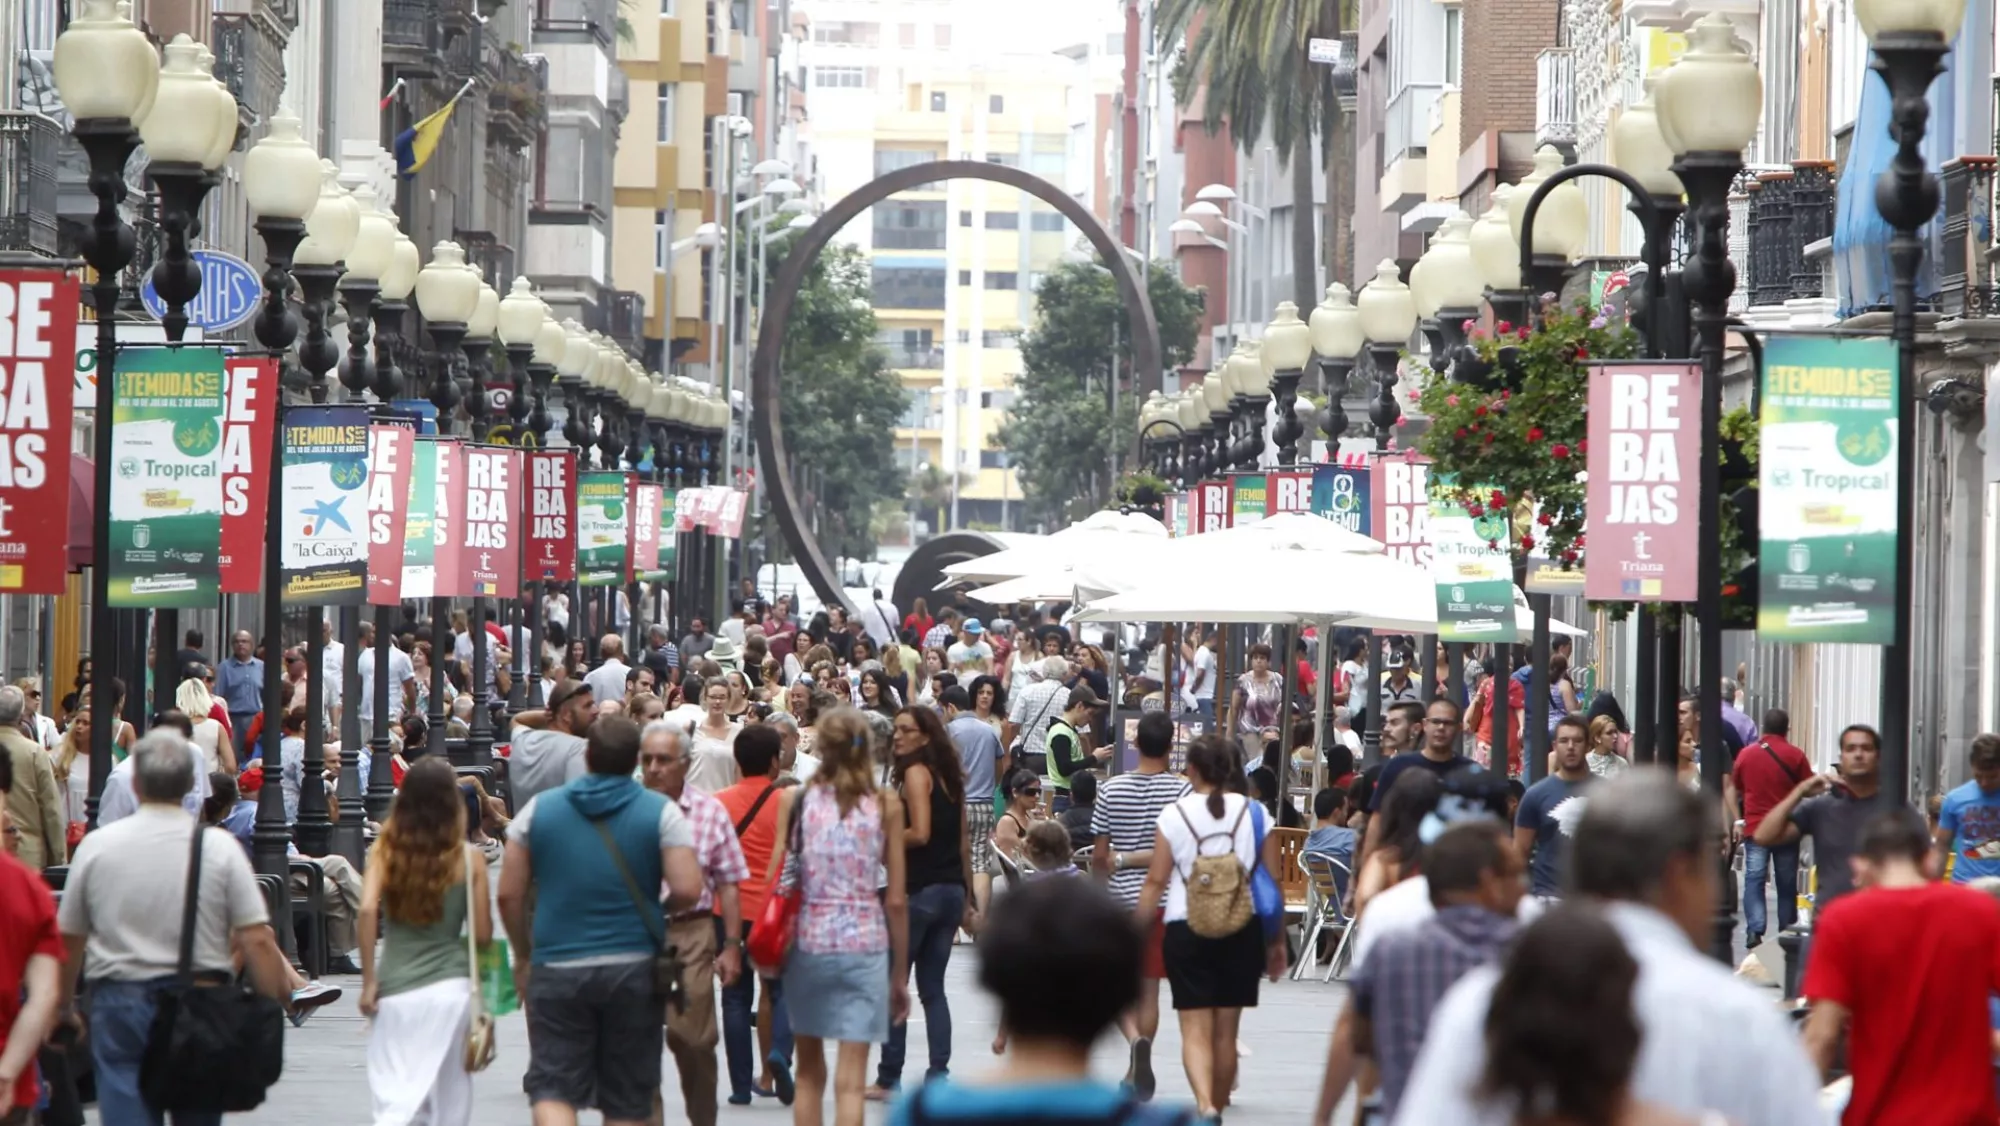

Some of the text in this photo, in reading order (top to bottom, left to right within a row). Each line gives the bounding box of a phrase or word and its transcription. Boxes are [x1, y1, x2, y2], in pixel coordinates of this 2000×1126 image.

[125, 372, 205, 397] TEMUDAS
[1777, 365, 1875, 397] TEMUDAS
[0, 362, 49, 429] A
[1610, 374, 1680, 430] RE
[292, 426, 355, 446] TEMUDAS
[1609, 432, 1681, 482] BA
[145, 460, 216, 481] Tropical
[468, 453, 508, 490] RE
[532, 456, 567, 488] RE
[1801, 469, 1889, 494] Tropical
[467, 489, 508, 523] BA
[533, 489, 567, 516] BA
[1239, 488, 1266, 501] TEMUD
[1277, 477, 1313, 510] RE
[1606, 484, 1678, 525] JAS
[465, 523, 507, 549] JAS
[532, 517, 566, 539] JAS
[592, 521, 623, 531] Tropical
[539, 558, 560, 567] Triana
[1455, 543, 1510, 558] Tropical
[472, 570, 498, 580] Triana
[1619, 560, 1664, 573] Triana
